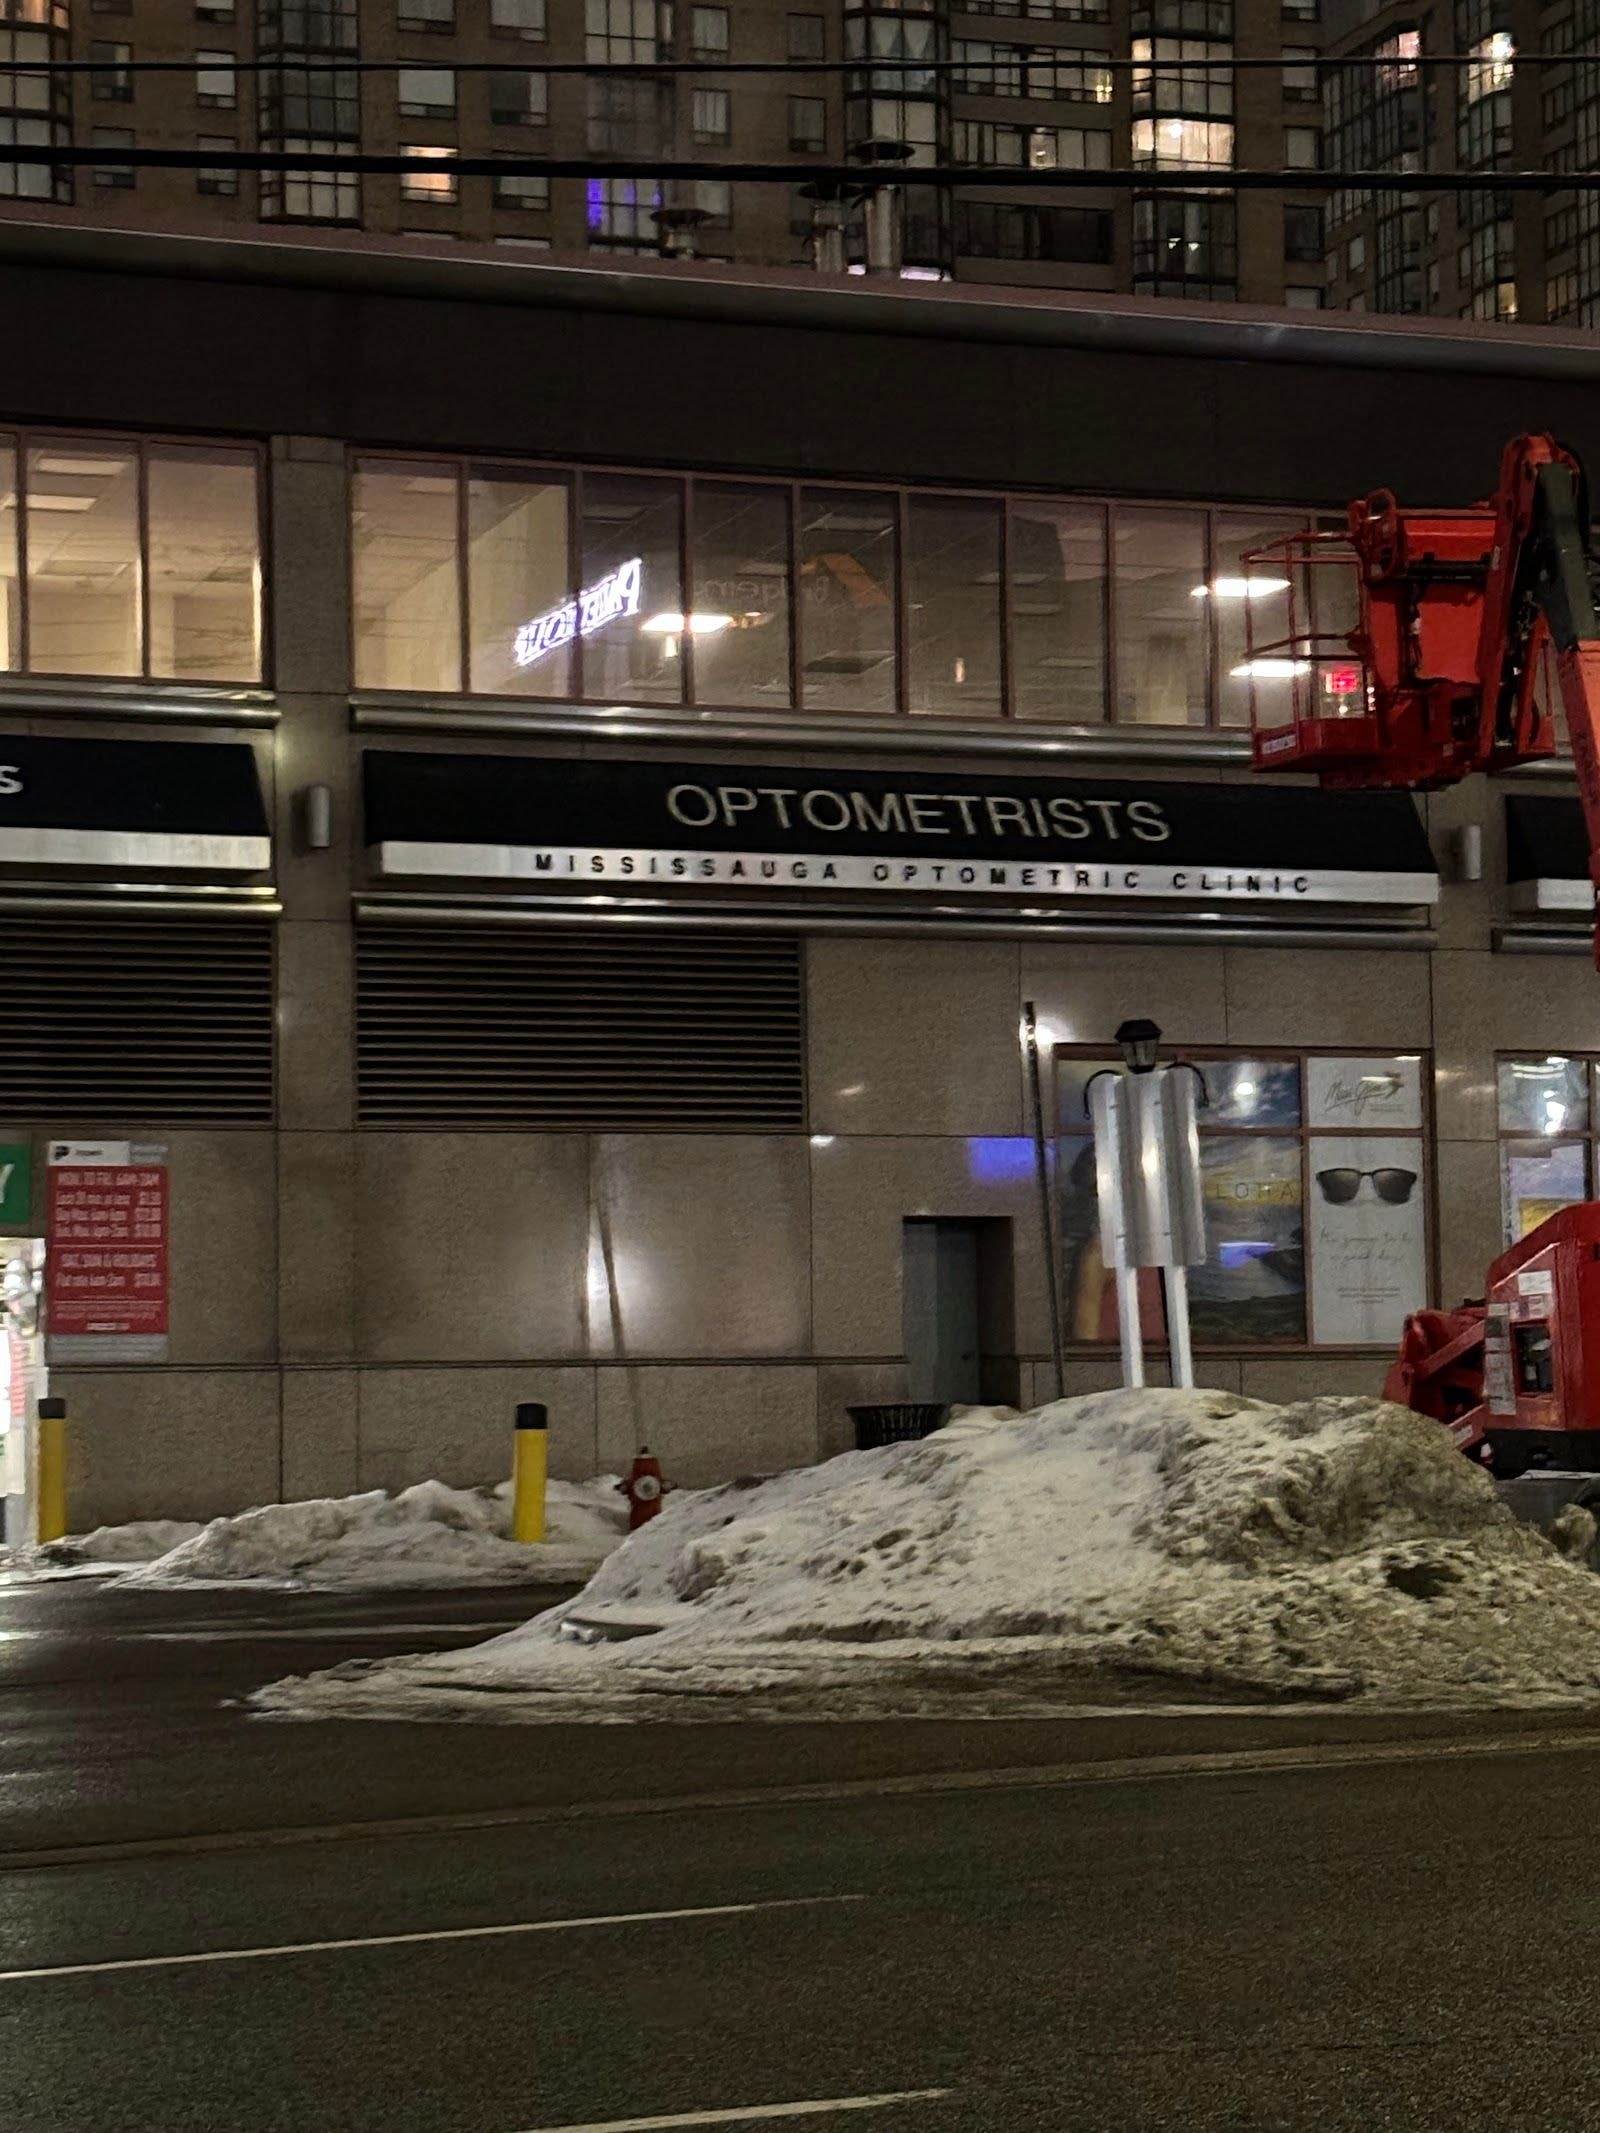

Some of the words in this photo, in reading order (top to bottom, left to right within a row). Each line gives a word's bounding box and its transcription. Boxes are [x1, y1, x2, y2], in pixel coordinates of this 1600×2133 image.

[666, 784, 1171, 842] OPTOMETRISTS
[535, 853, 837, 879] MISSISSAUGA
[874, 863, 1140, 888] OPTOMETRIC
[1172, 872, 1308, 893] CLINIC
